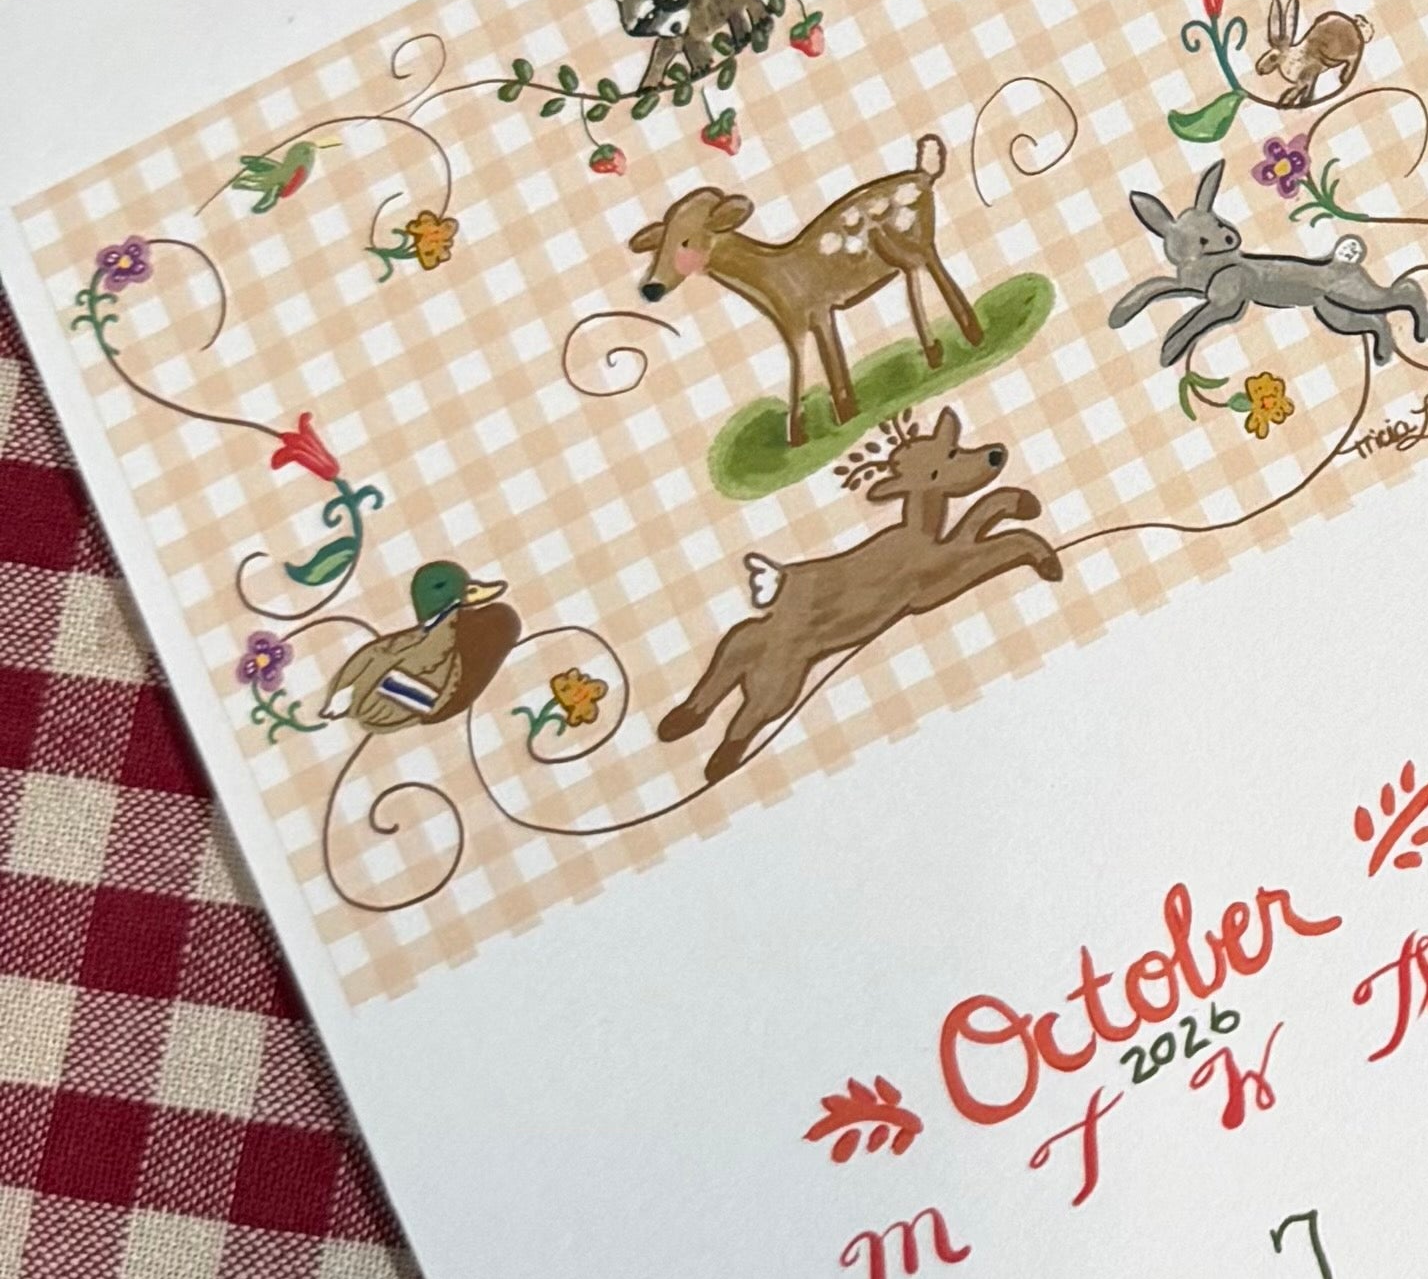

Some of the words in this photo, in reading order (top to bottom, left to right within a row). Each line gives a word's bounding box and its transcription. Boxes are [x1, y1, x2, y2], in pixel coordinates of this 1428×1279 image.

[939, 882, 1343, 1126] October
[1118, 1001, 1242, 1086] 2026
[1028, 1086, 1125, 1208] T
[1189, 1020, 1285, 1131] W
